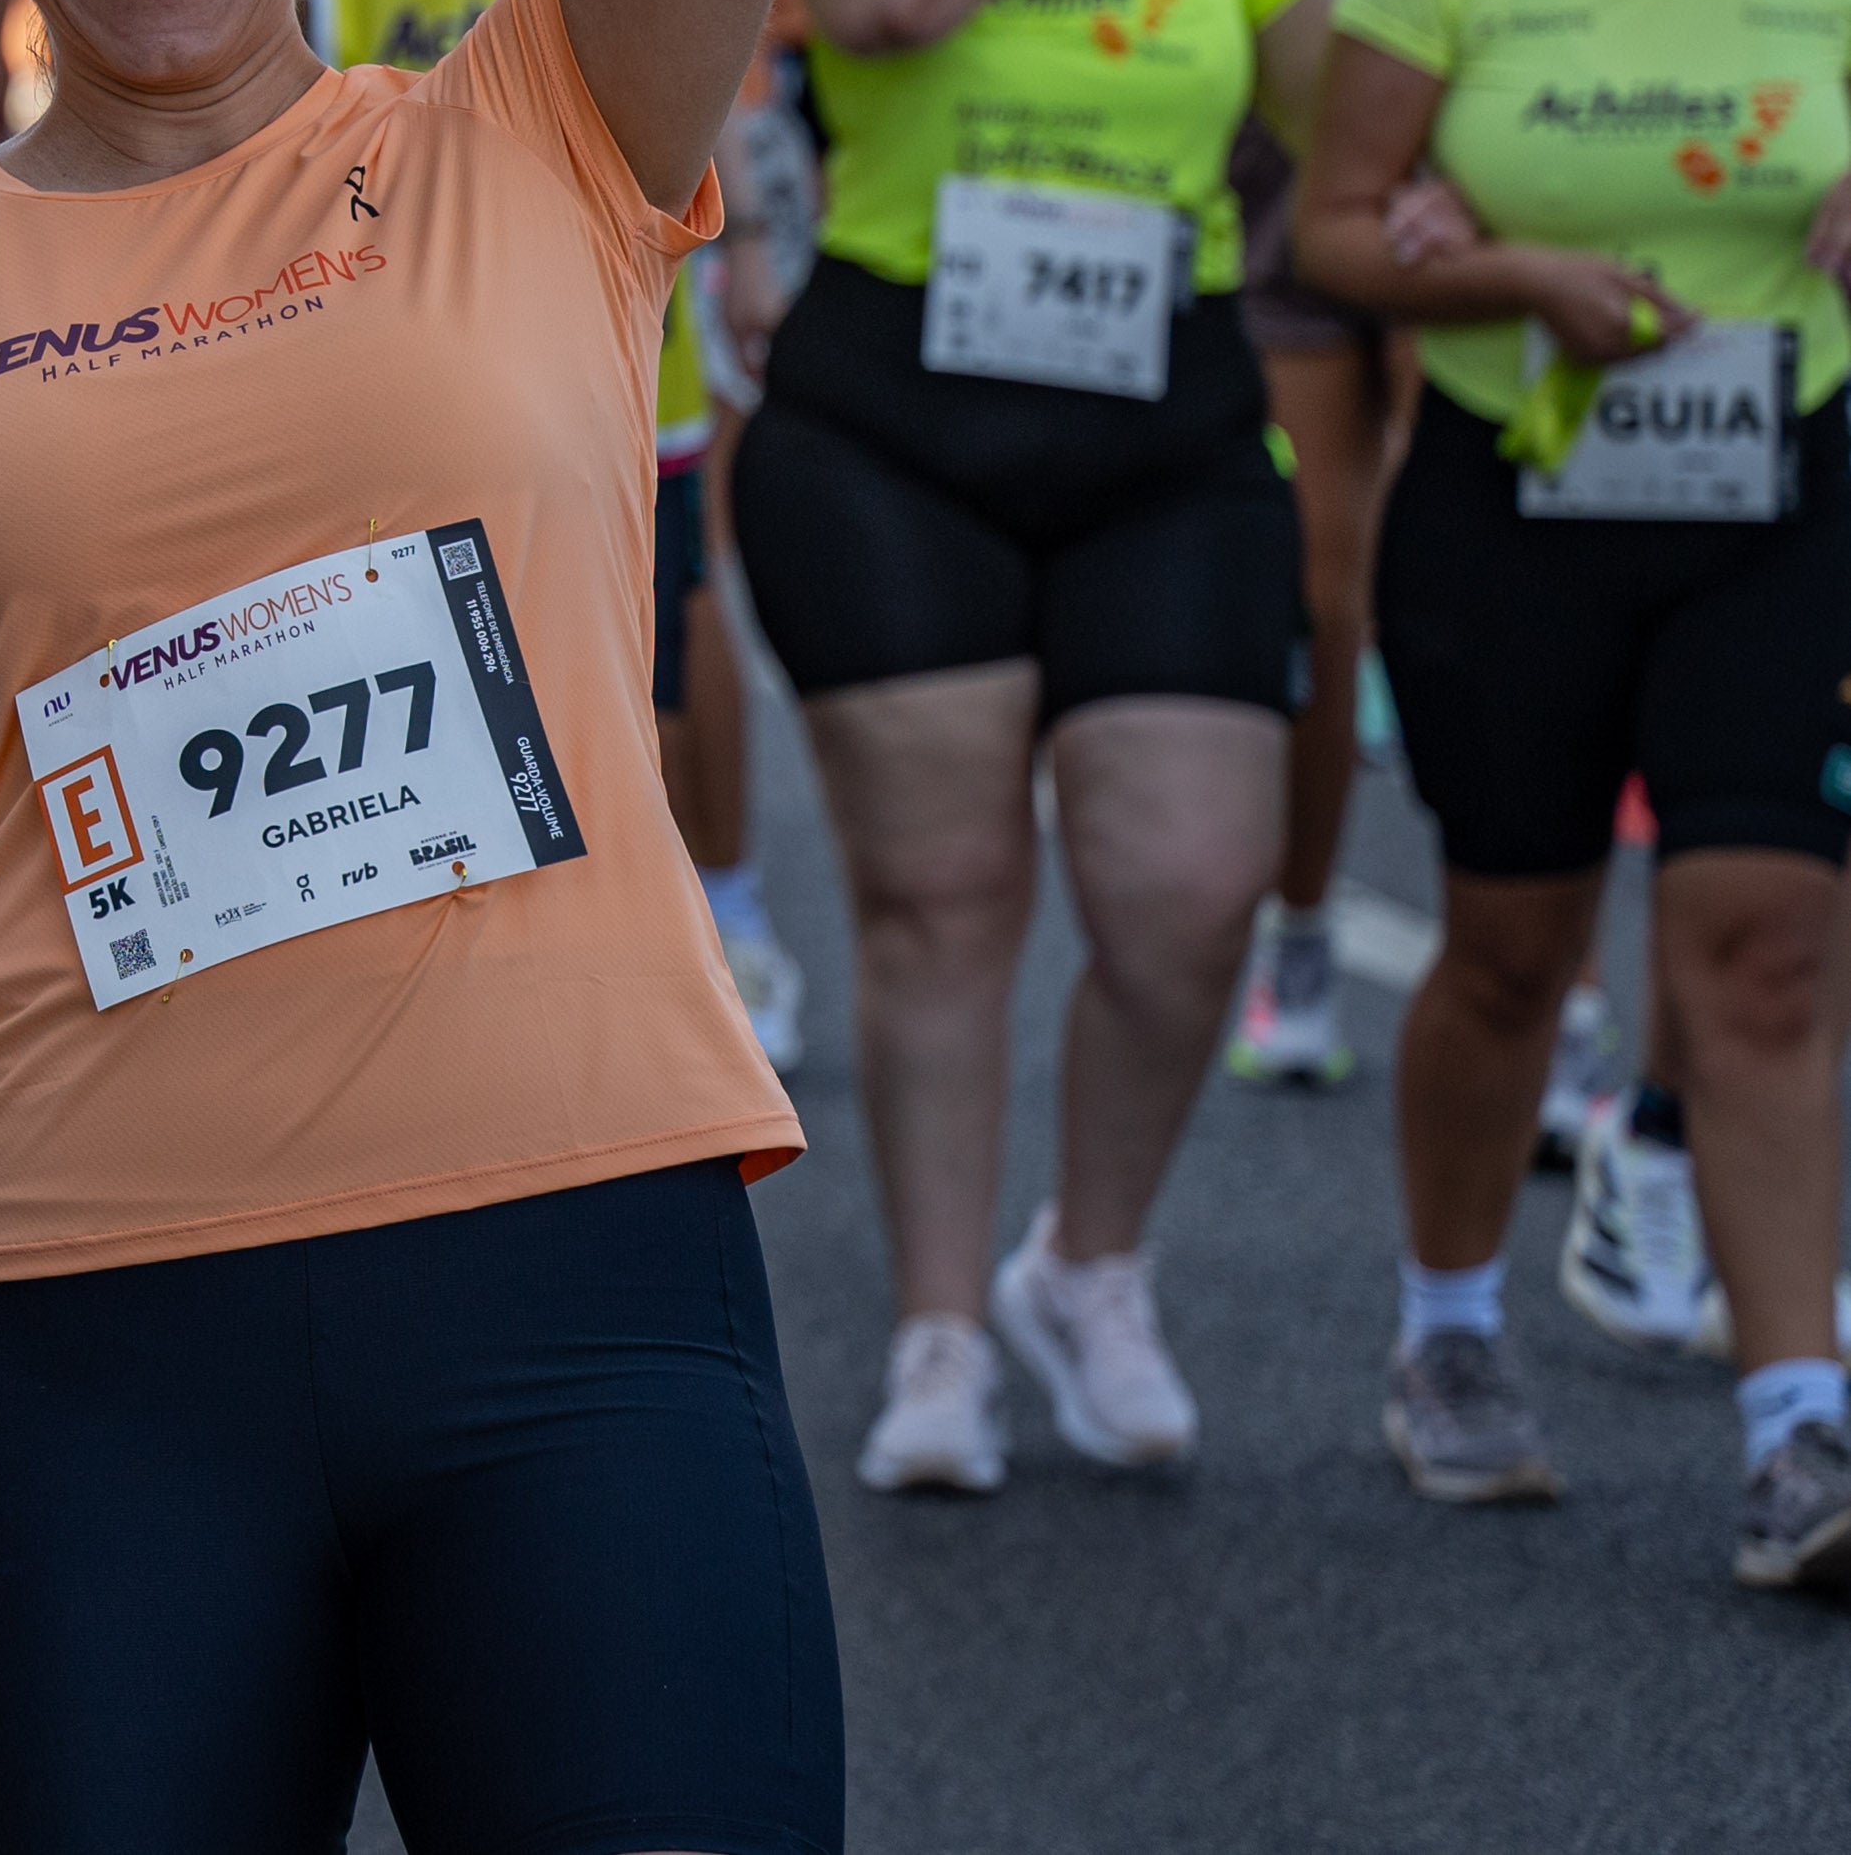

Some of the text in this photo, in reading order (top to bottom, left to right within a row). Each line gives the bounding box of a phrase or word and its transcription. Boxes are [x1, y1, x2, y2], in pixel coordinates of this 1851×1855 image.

[162, 244, 388, 337] WOMEN'S
[42, 295, 326, 383] HALF MARATHON
[1597, 384, 1765, 445] GUIA
[110, 574, 352, 690] VENUS WOMEN'S
[163, 620, 315, 691] HALF MARATHON
[466, 599, 498, 673] 11 955 006 296
[488, 620, 499, 633] DE
[43, 691, 71, 718] nu
[180, 662, 435, 817] 9277
[62, 775, 113, 867] E
[262, 785, 421, 848] GABRIELA
[510, 772, 539, 812] 9277
[517, 736, 564, 840] GUARDA-VOLUME
[342, 862, 378, 887] rvb
[409, 834, 477, 866] BRASIL
[89, 876, 135, 919] 5K
